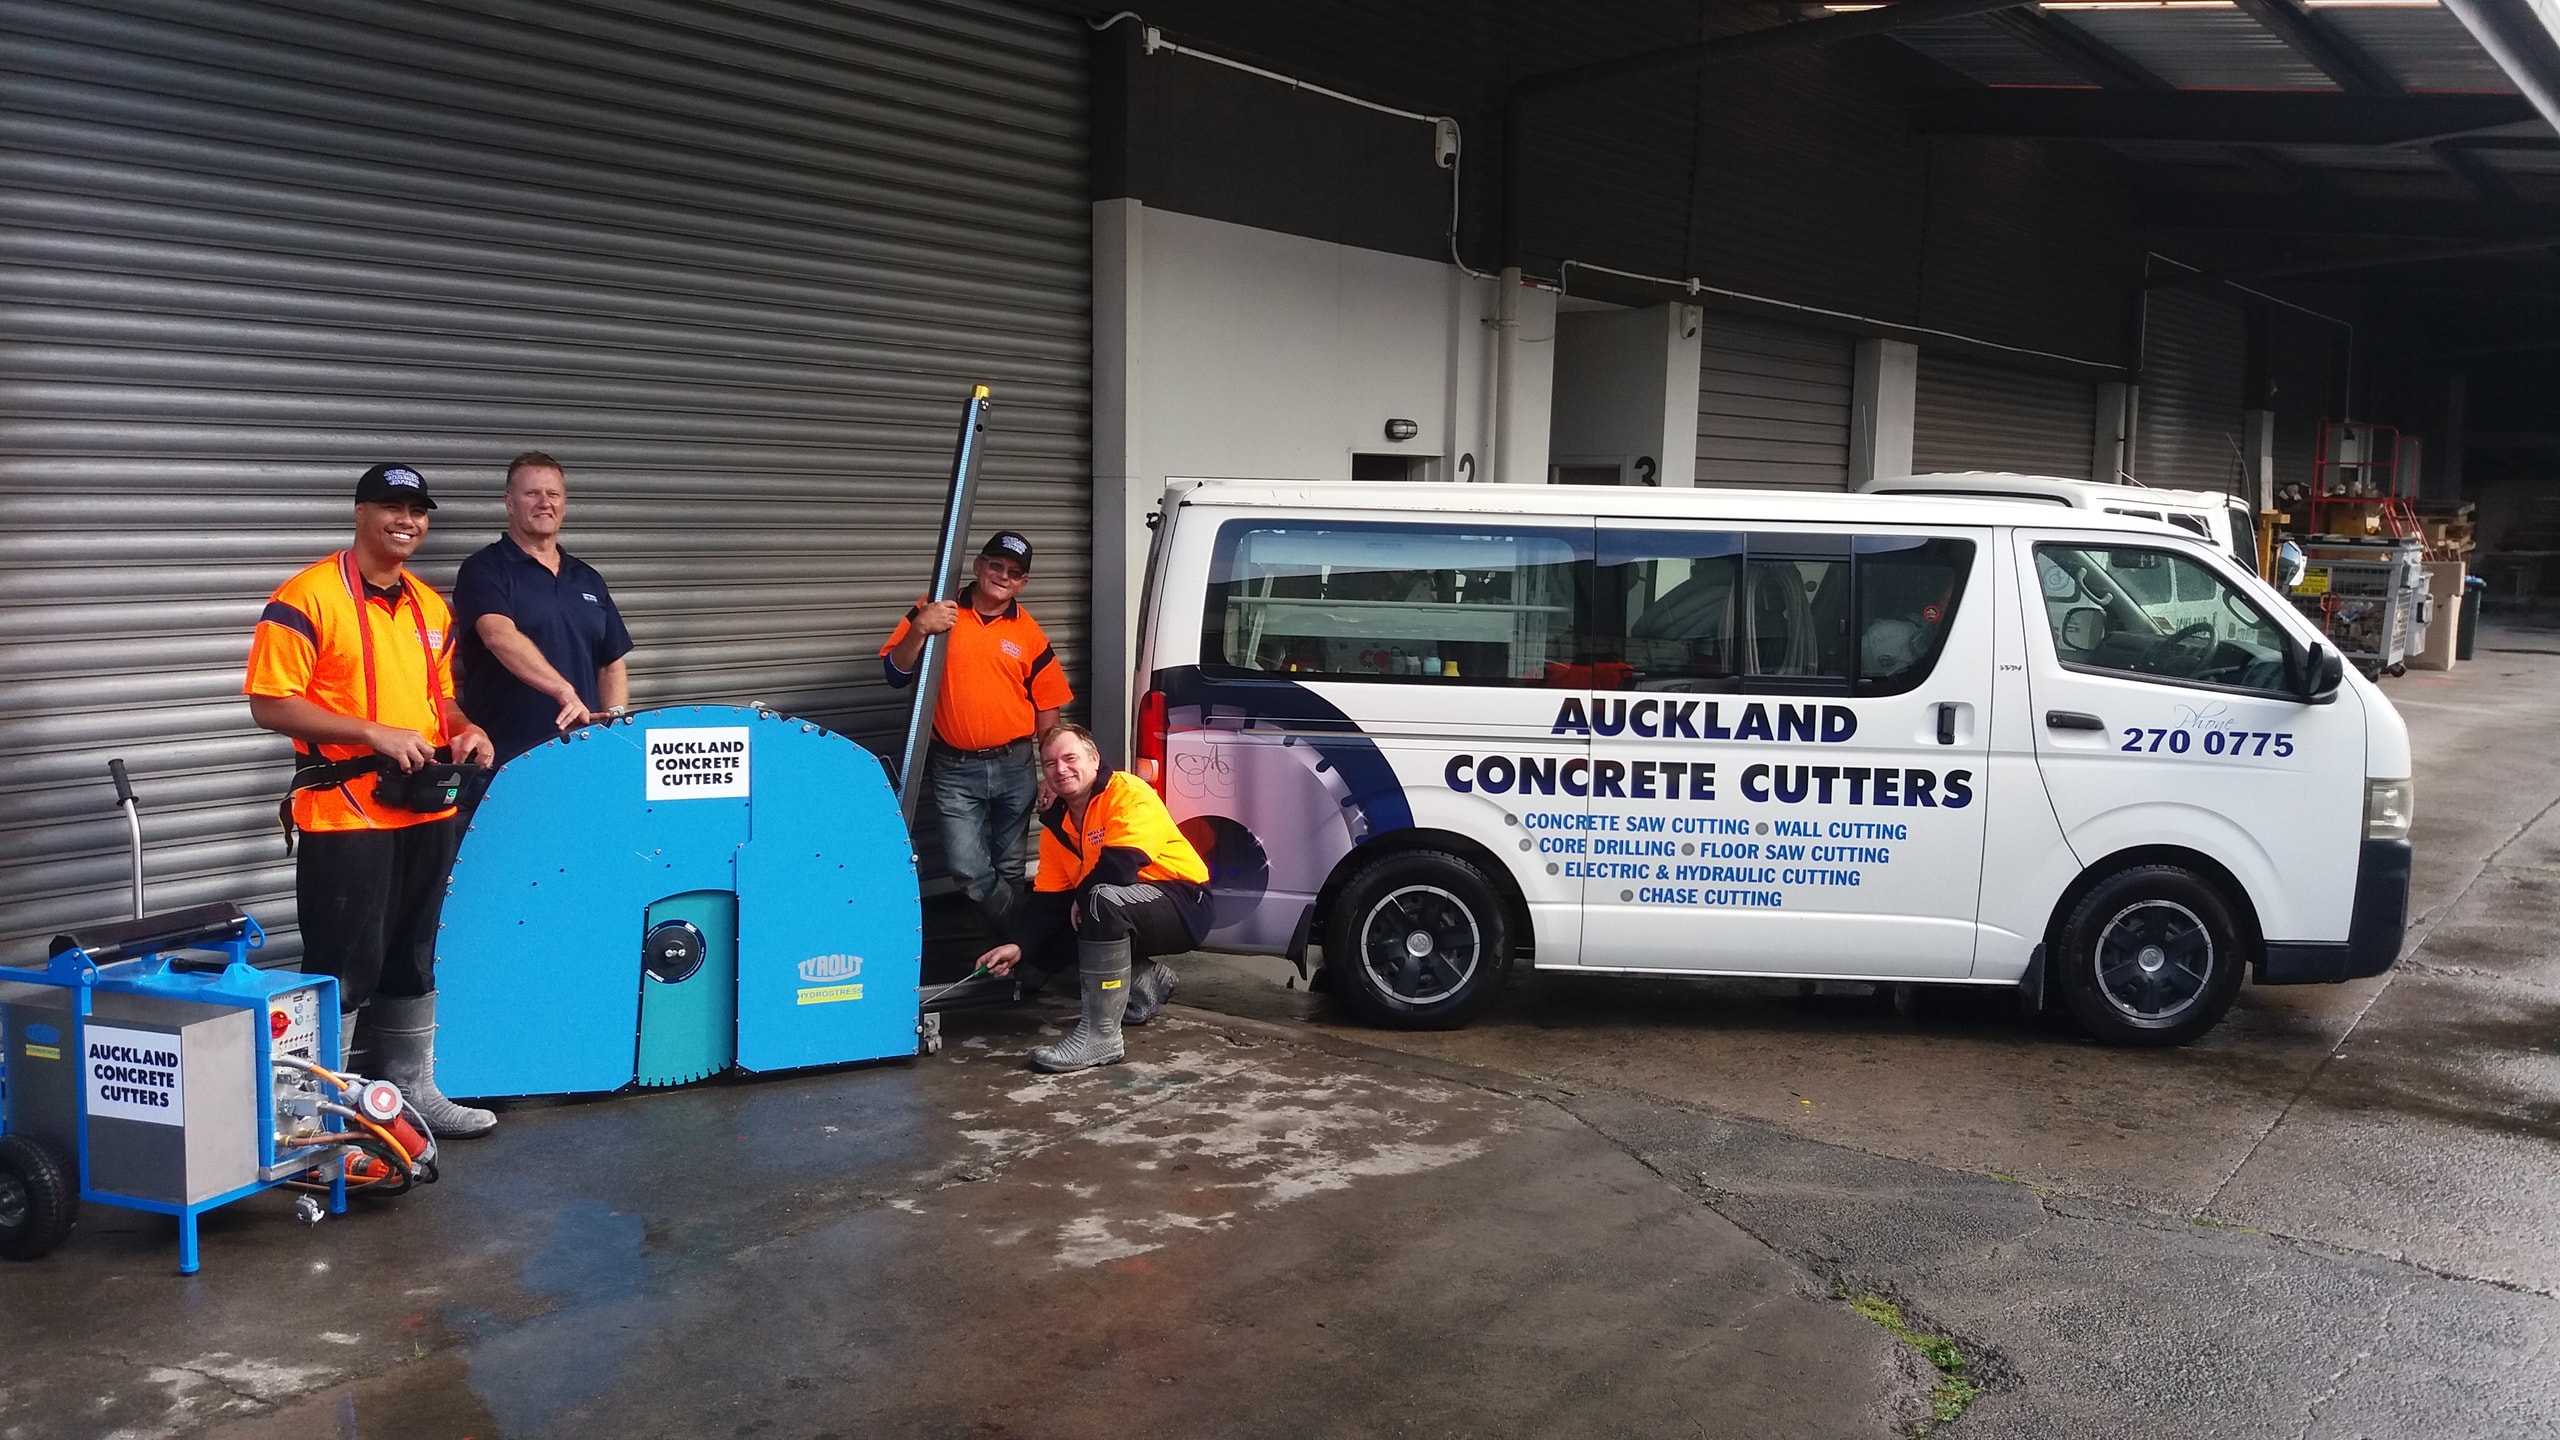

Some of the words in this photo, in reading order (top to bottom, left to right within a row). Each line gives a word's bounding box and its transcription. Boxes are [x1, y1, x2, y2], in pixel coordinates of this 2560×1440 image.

[1551, 697, 1857, 743] AUCKLAND
[2174, 700, 2235, 730] Phone
[651, 741, 744, 755] AUCKLAND
[2121, 727, 2191, 754] 270
[2203, 730, 2294, 758] 0775
[655, 757, 740, 771] CONCRETE
[662, 772, 733, 786] CUTTERS
[1444, 754, 1716, 801] CONCRETE
[1740, 763, 1973, 809] CUTTERS
[1524, 813, 1620, 832] CONCRETE
[1626, 815, 1666, 833] SAW
[1671, 817, 1750, 836] CUTTING
[1774, 820, 1822, 838] WALL
[1828, 822, 1908, 840] CUTTING
[1539, 837, 1587, 854] CORE
[1594, 838, 1676, 857] DRILLING
[1700, 842, 1760, 860] FLOOR
[1765, 844, 1806, 861] SAW
[1811, 846, 1890, 864] CUTTING
[1565, 861, 1650, 879] ELECTRIC
[1655, 864, 1670, 880] &
[1676, 865, 1776, 884] HYDRAULIC
[1782, 868, 1861, 886] CUTTING
[1638, 887, 1699, 905] CHASE
[1704, 888, 1783, 907] CUTTING
[797, 954, 864, 980] TYROLIT
[89, 1043, 179, 1068] AUCKLAND
[94, 1063, 175, 1088] CONCRETE
[101, 1085, 169, 1107] CUTTERS
